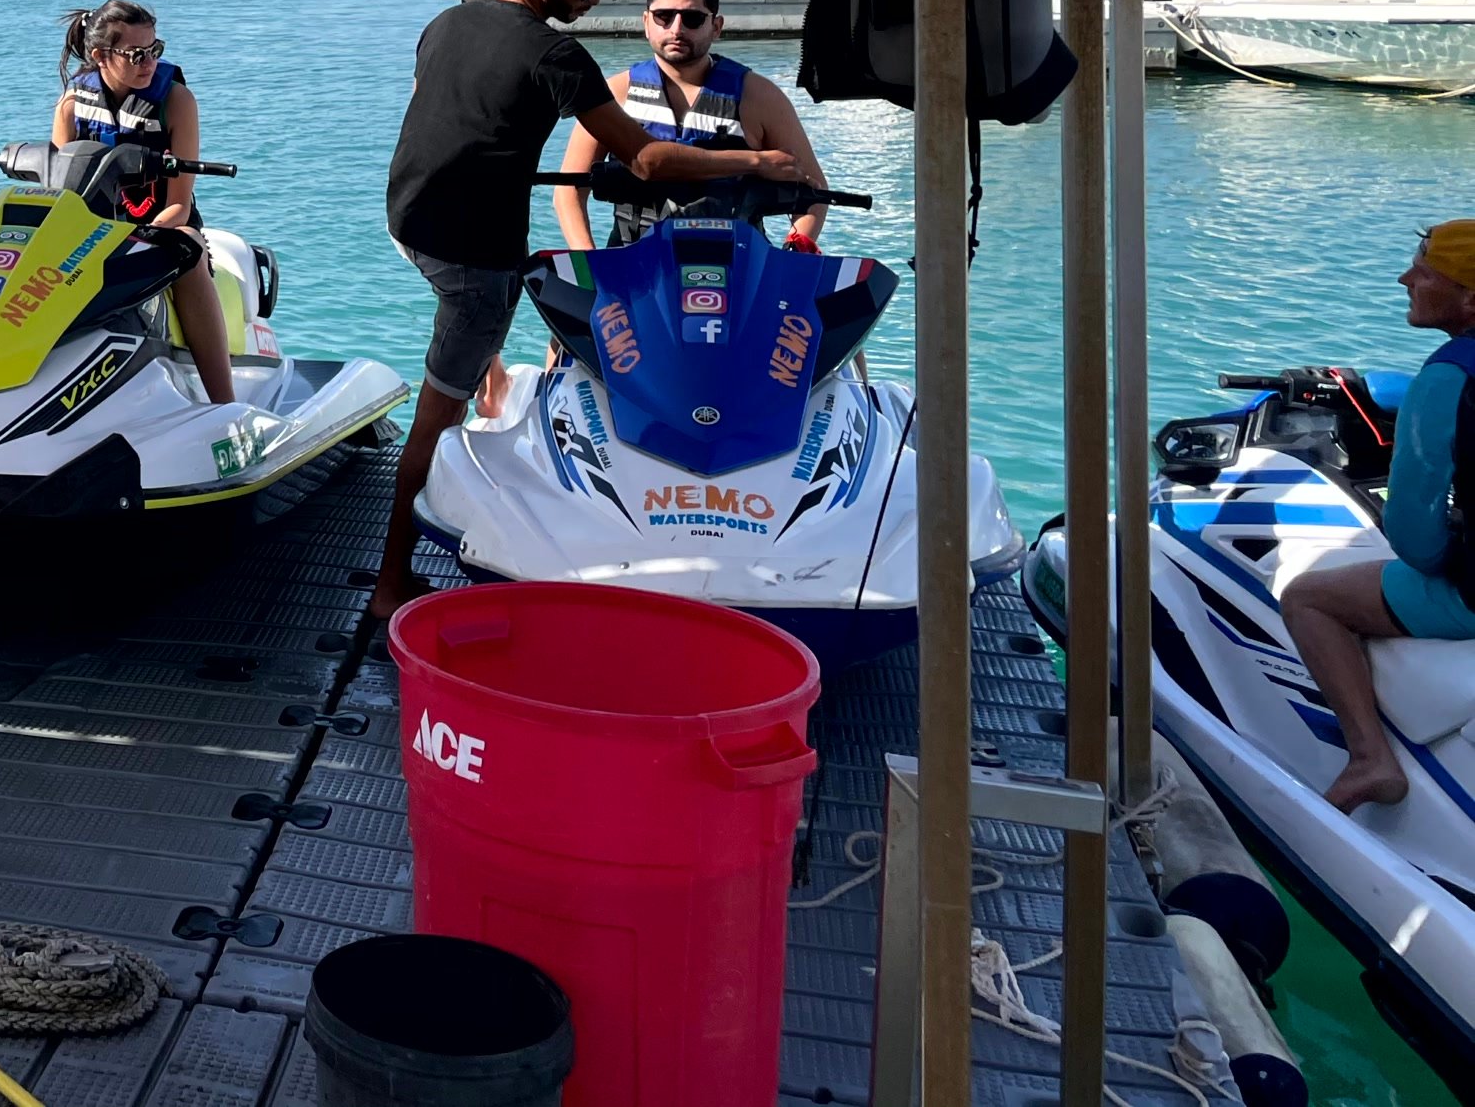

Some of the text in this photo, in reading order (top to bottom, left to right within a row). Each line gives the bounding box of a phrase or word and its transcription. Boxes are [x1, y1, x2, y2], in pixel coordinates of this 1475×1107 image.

[57, 221, 115, 275] WATERSPORTS
[0, 266, 65, 328] NEMO
[596, 302, 642, 374] NEMO
[768, 314, 814, 388] NEMO
[60, 353, 117, 411] VX-C
[575, 379, 613, 470] WATERSPORTS DUBAI
[791, 410, 832, 483] WATERSPORTS
[643, 484, 776, 520] NEMO
[648, 513, 769, 535] WATERSPORTS
[690, 529, 725, 539] DUBAI
[412, 706, 486, 784] ACE
